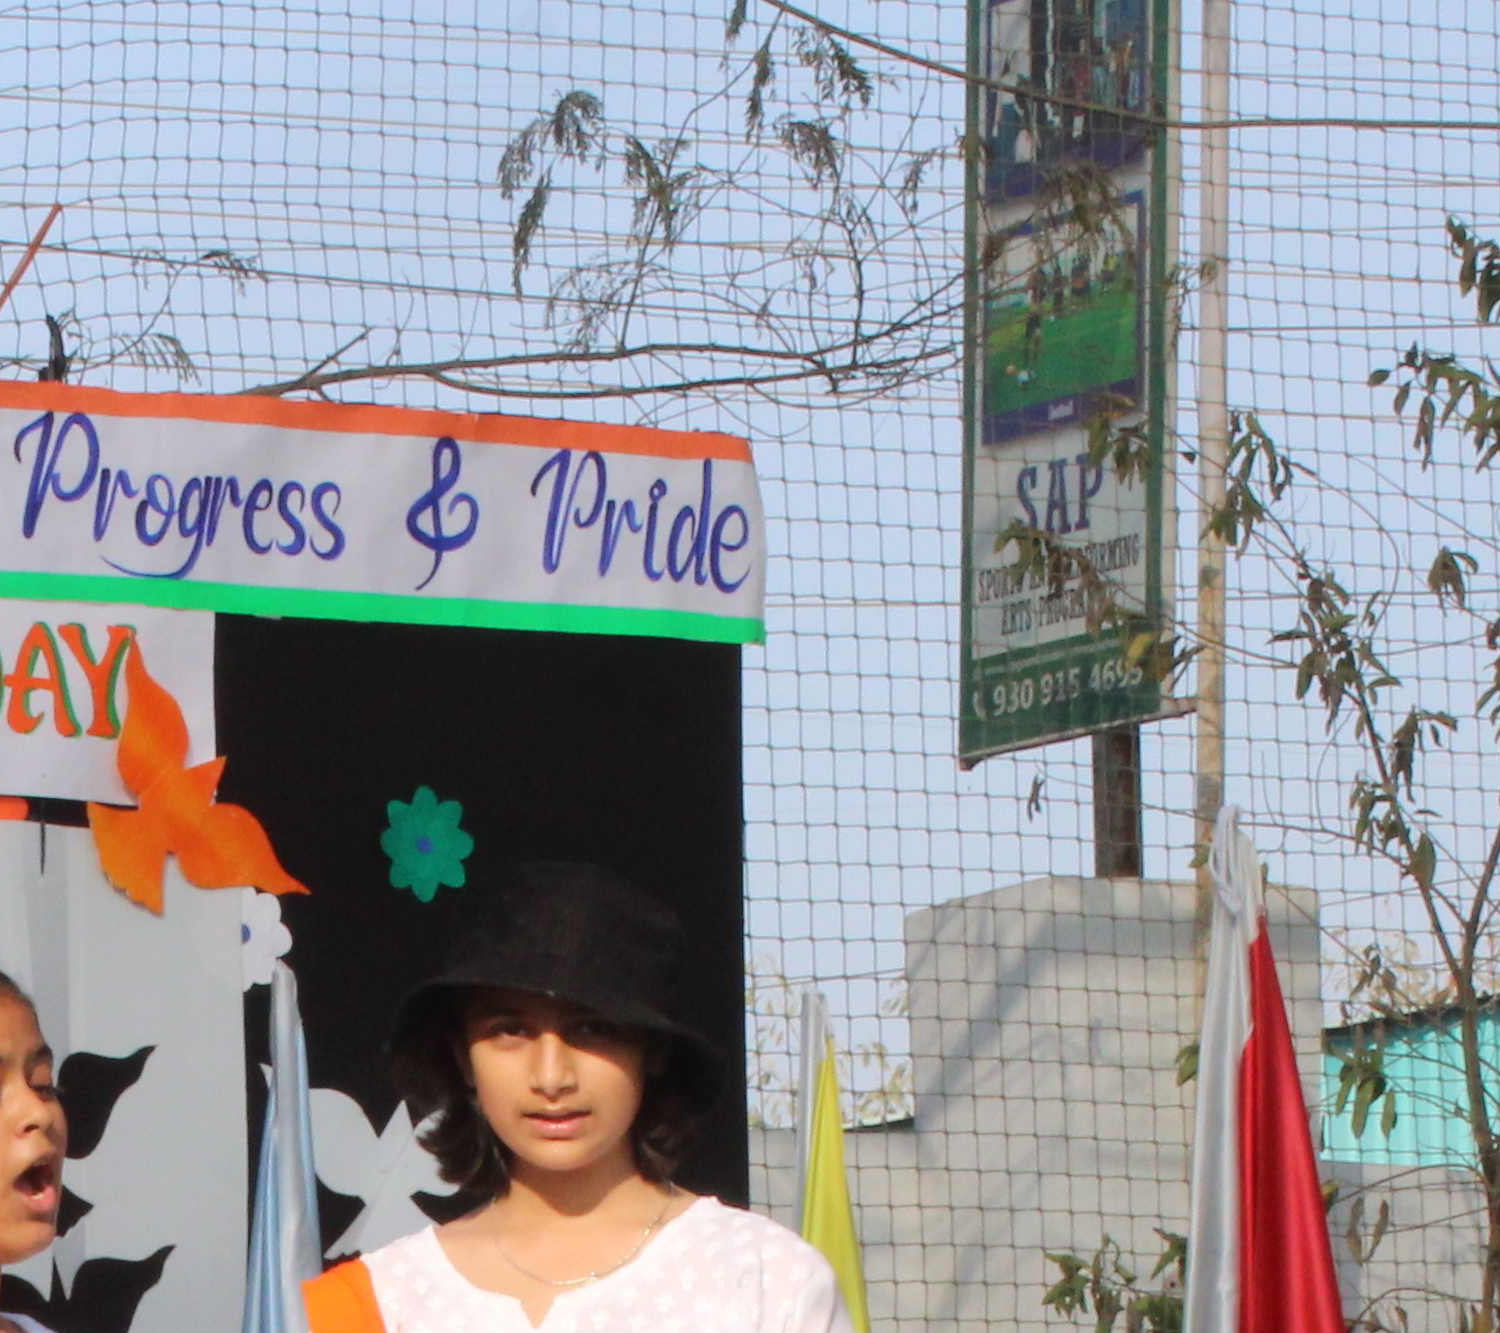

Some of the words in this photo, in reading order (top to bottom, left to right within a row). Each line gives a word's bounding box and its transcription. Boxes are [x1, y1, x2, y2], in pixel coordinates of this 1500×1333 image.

[11, 407, 346, 577] Progress
[405, 437, 480, 591] &
[530, 447, 752, 595] Pride
[1017, 452, 1104, 538] SAP
[993, 677, 1034, 716] 930
